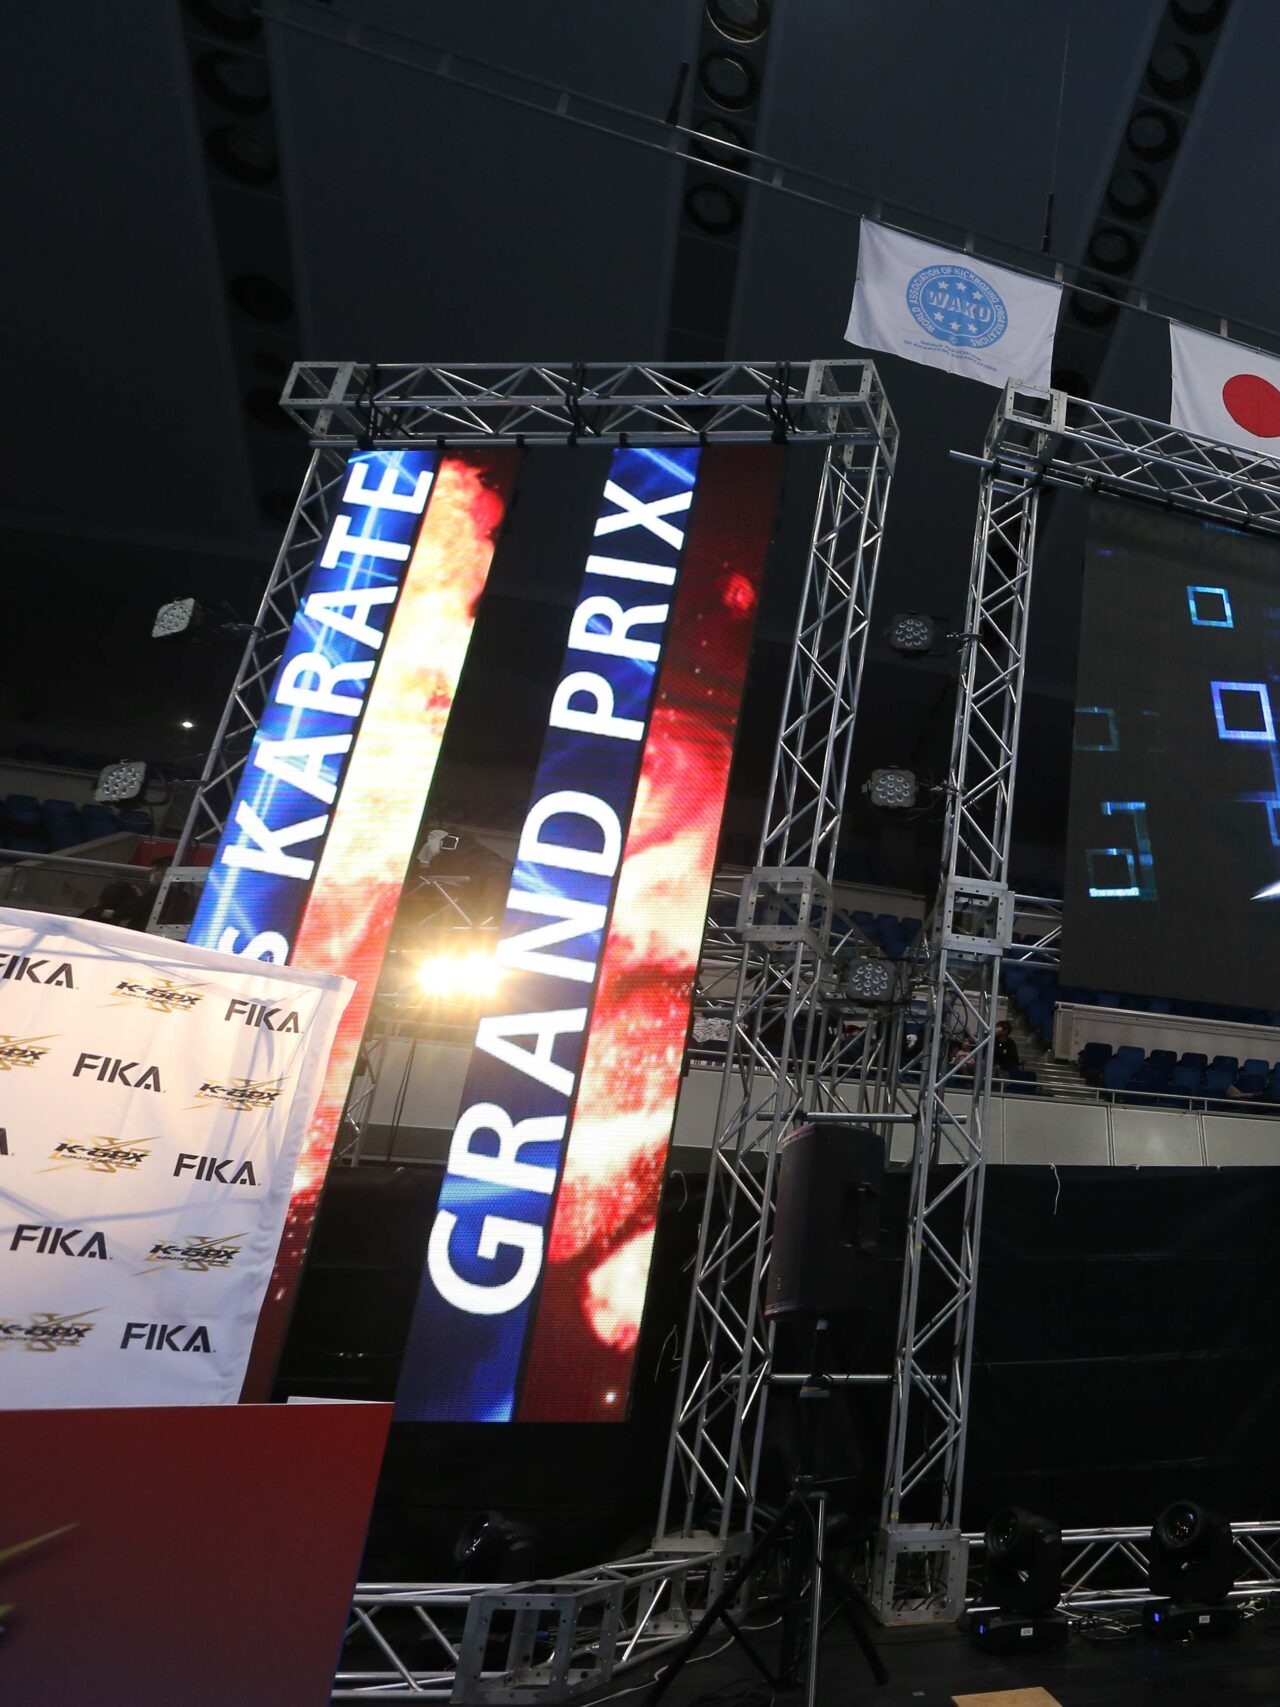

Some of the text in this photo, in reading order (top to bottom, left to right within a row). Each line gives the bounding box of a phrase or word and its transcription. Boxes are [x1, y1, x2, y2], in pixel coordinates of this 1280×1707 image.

[221, 462, 434, 881] KARATE
[428, 479, 695, 1315] GRAND PRIX
[224, 999, 300, 1034] FIKA
[72, 1052, 162, 1093] FIKA
[172, 1153, 257, 1186] FIKA
[9, 1224, 108, 1260] FIKA
[119, 1322, 212, 1354] FIKA
